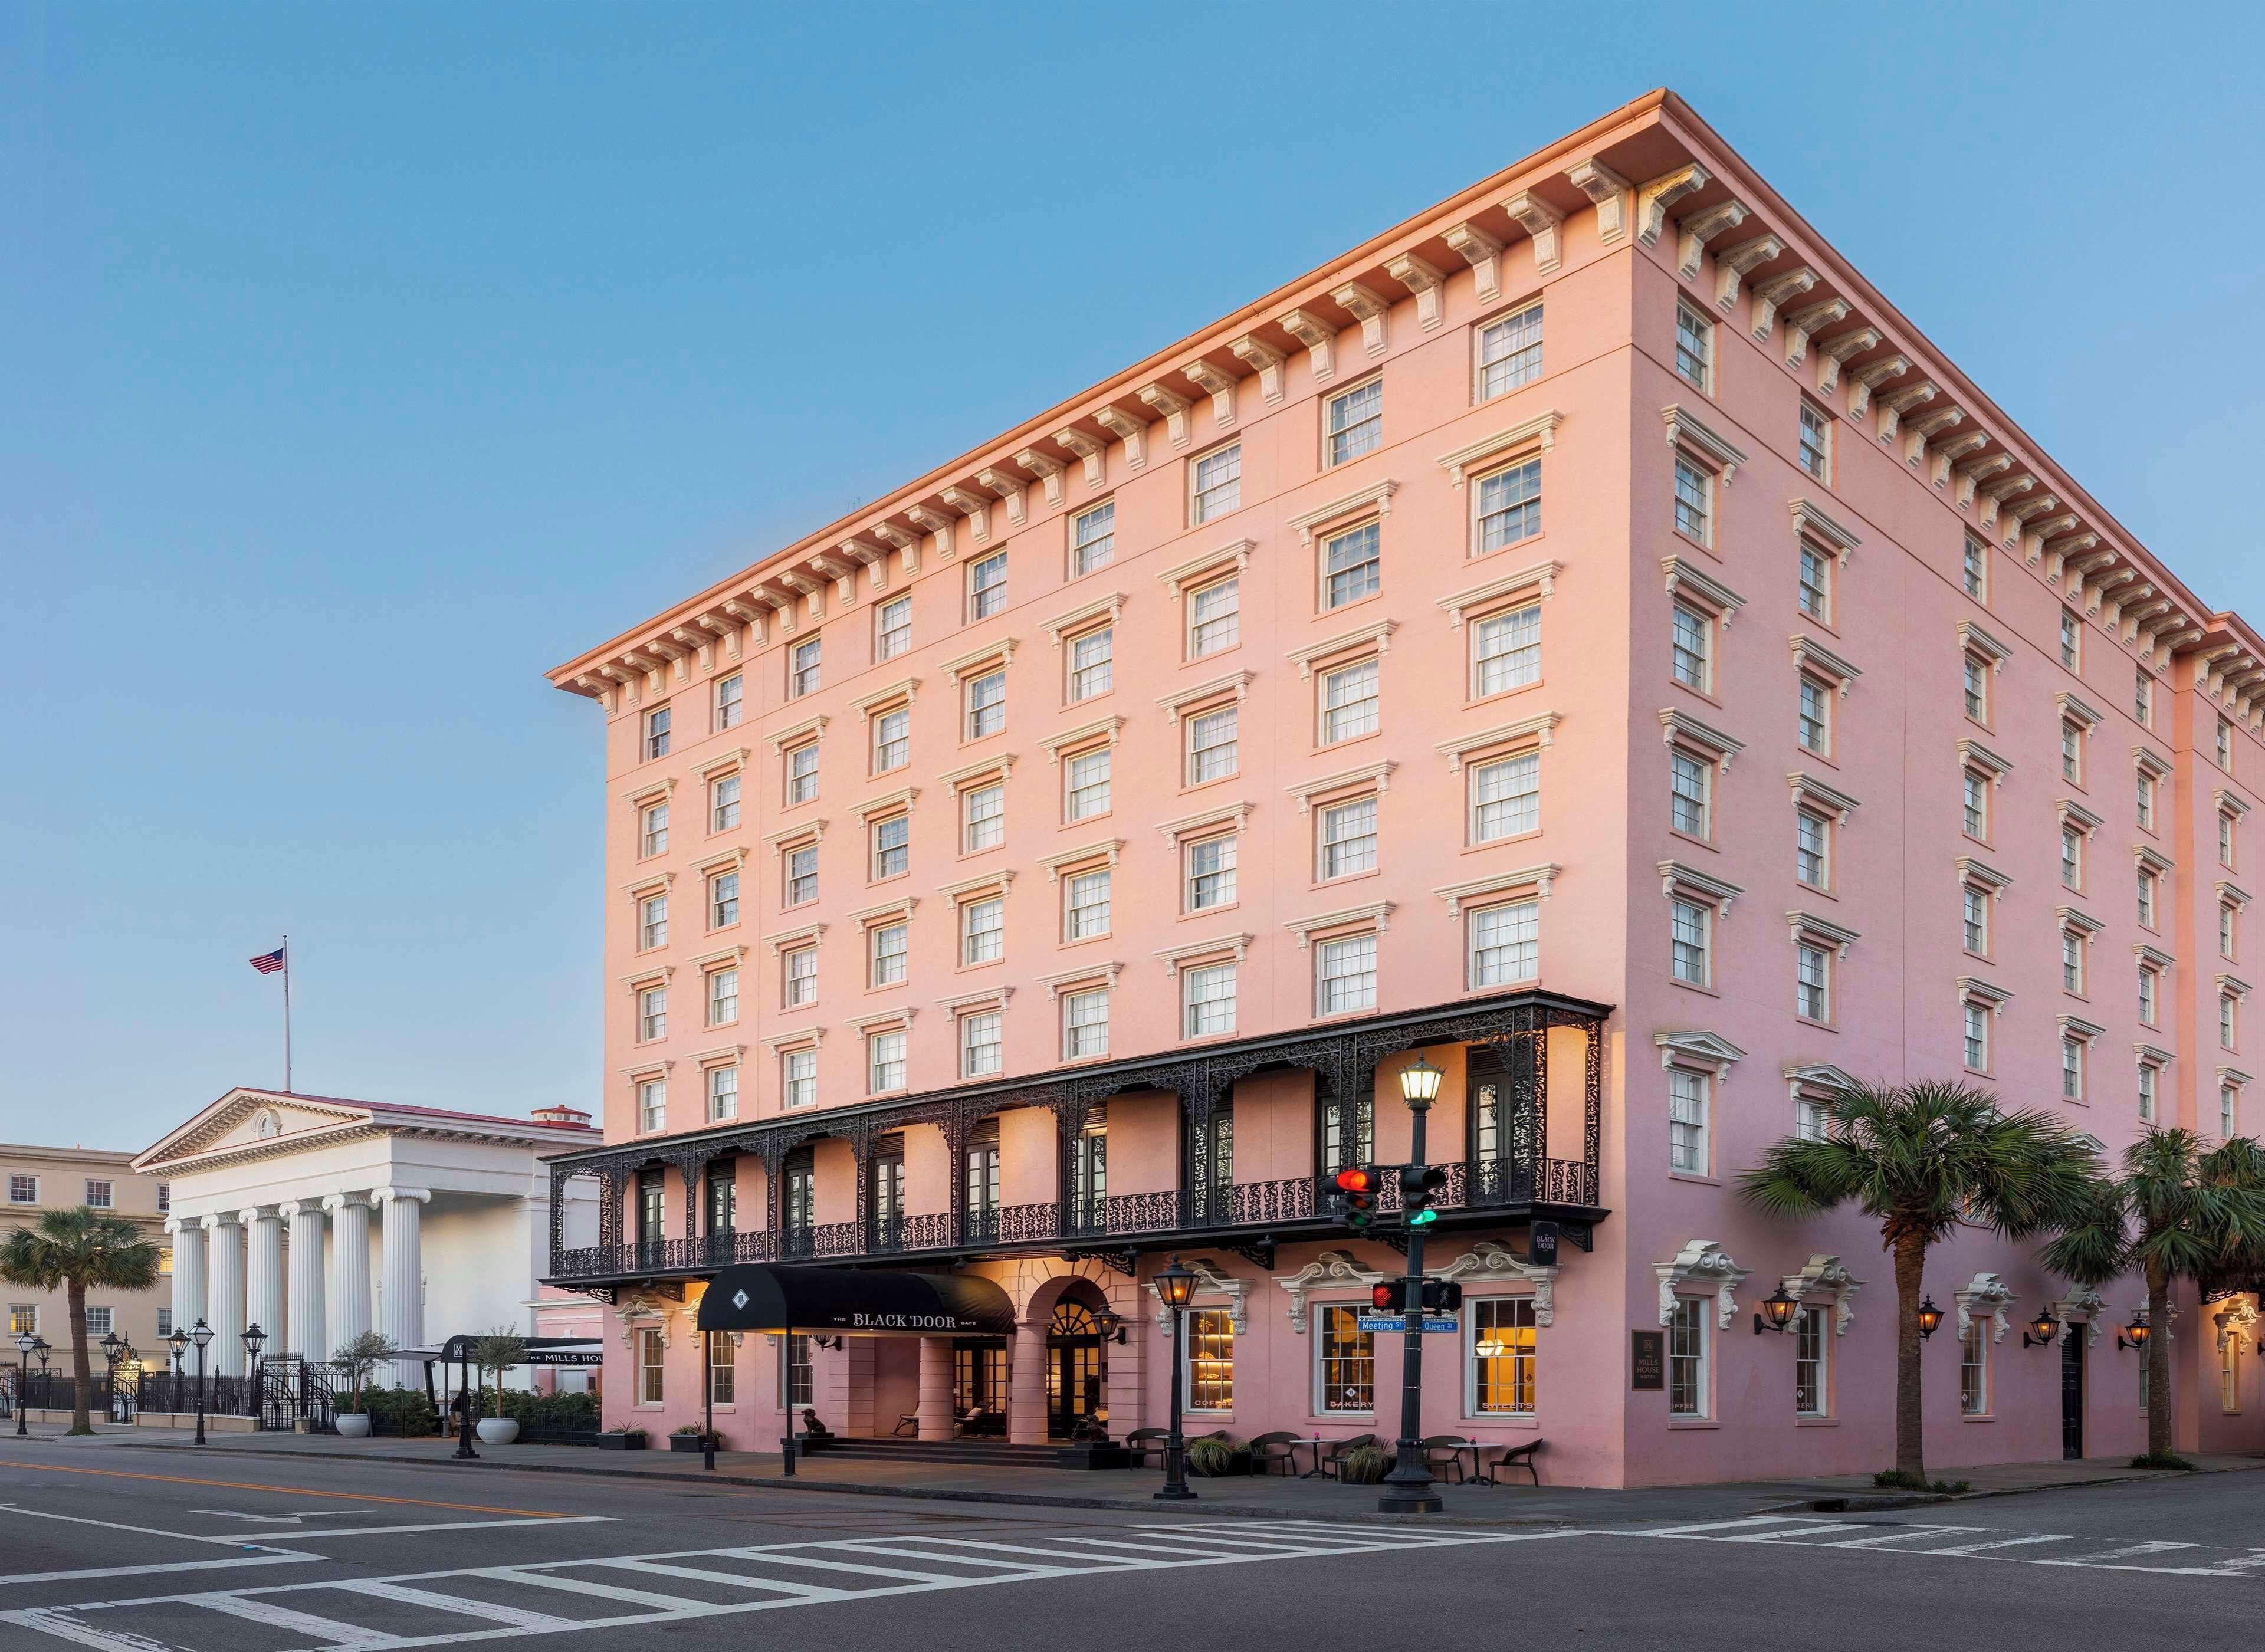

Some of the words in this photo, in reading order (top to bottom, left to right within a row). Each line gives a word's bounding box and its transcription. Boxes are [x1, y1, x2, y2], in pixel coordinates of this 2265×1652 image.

[854, 1313, 907, 1326] BLACK
[910, 1315, 956, 1328] DOOR
[1363, 1322, 1393, 1330] Meeting
